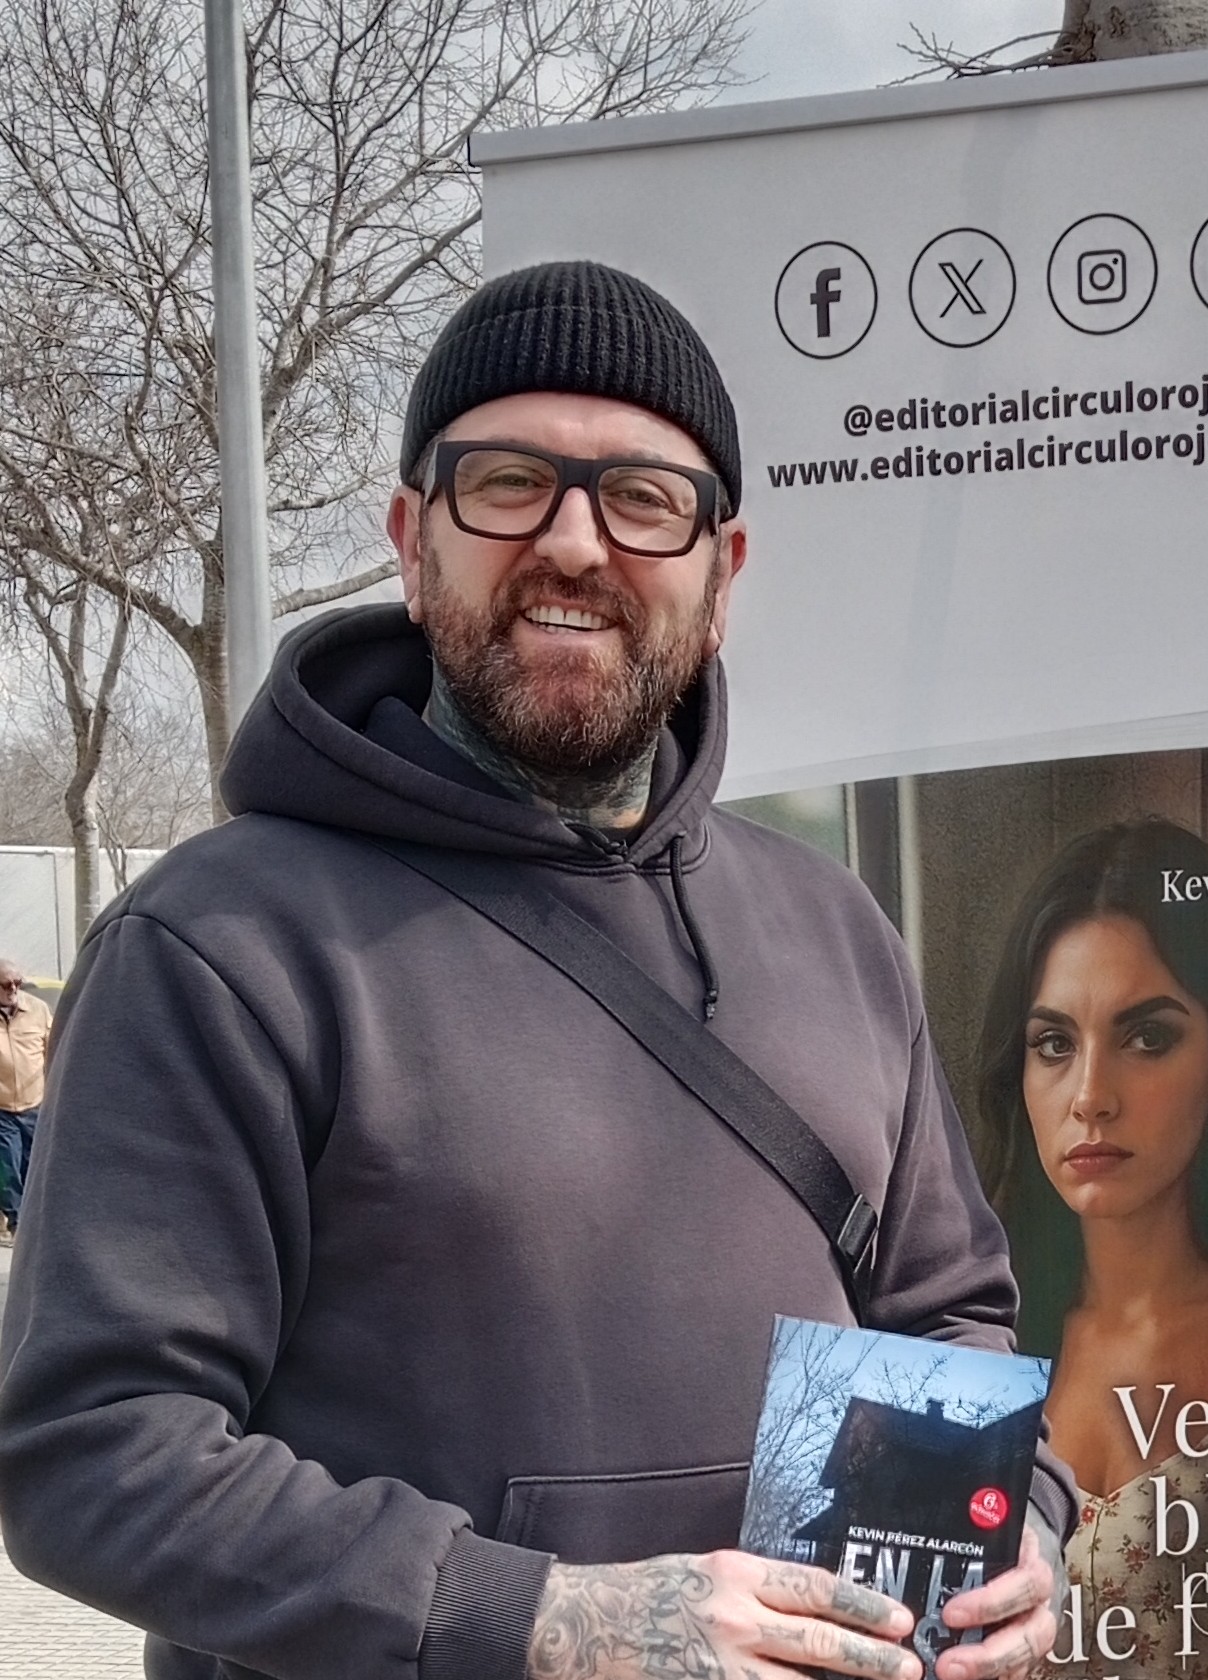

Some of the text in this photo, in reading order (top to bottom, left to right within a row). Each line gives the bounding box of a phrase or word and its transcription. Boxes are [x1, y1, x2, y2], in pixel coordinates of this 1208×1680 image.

[848, 1525, 984, 1557] KEVIN PÉREZ ALARCÓN
[1046, 1584, 1137, 1664] de
